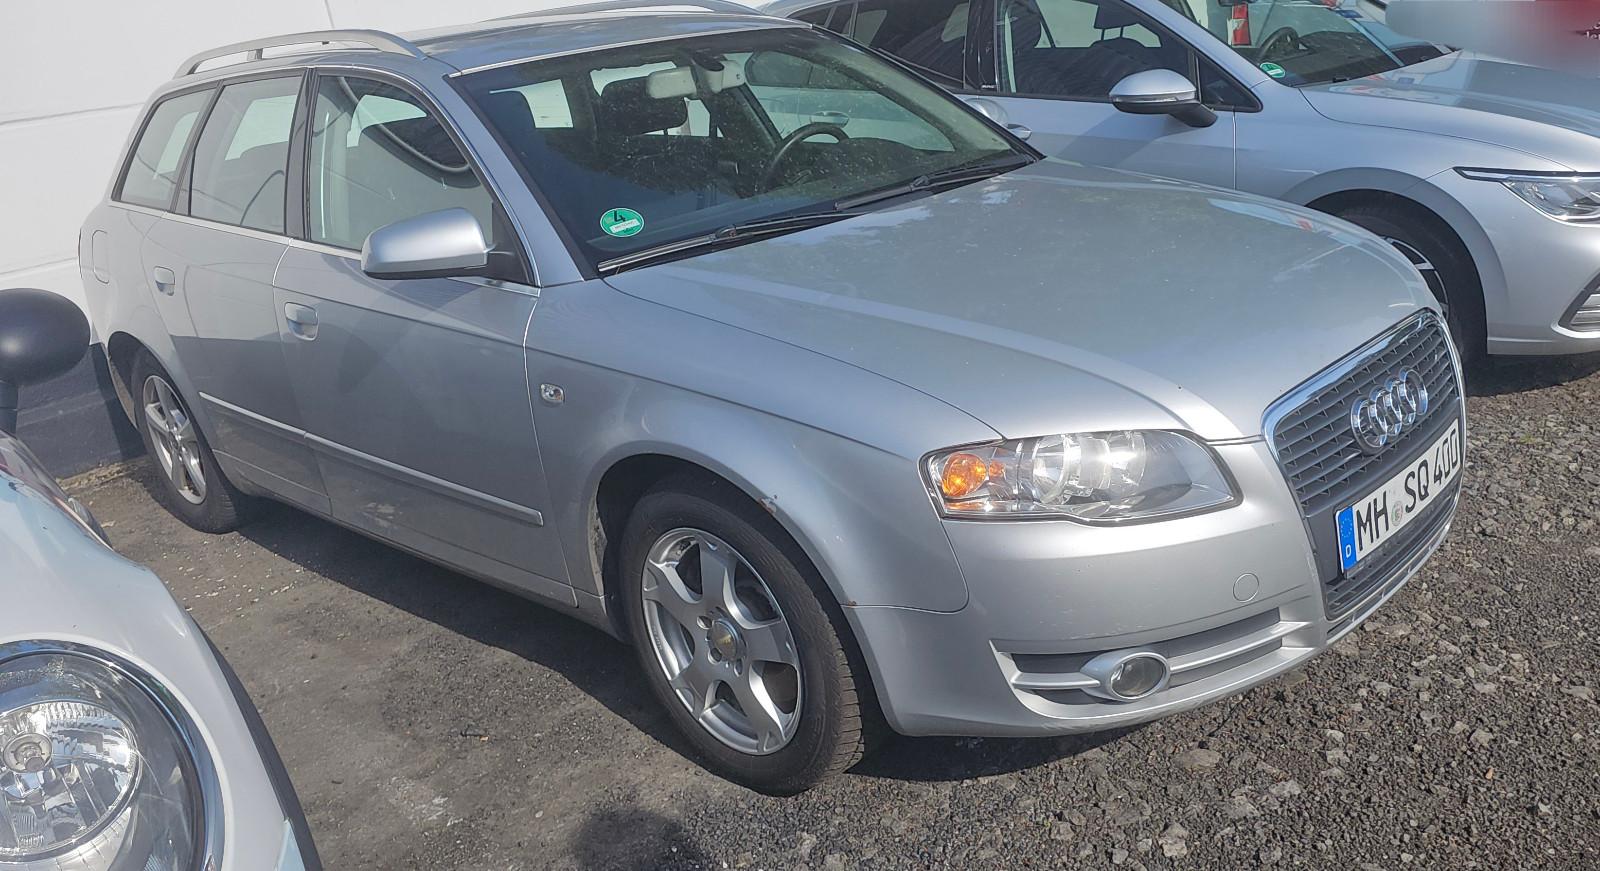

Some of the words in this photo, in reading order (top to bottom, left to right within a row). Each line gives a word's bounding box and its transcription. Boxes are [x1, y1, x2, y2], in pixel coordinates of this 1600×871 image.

[613, 210, 626, 222] 4
[1356, 490, 1390, 551] MH
[1404, 459, 1430, 513] SQ
[1433, 427, 1459, 485] 400
[1345, 544, 1353, 559] D
